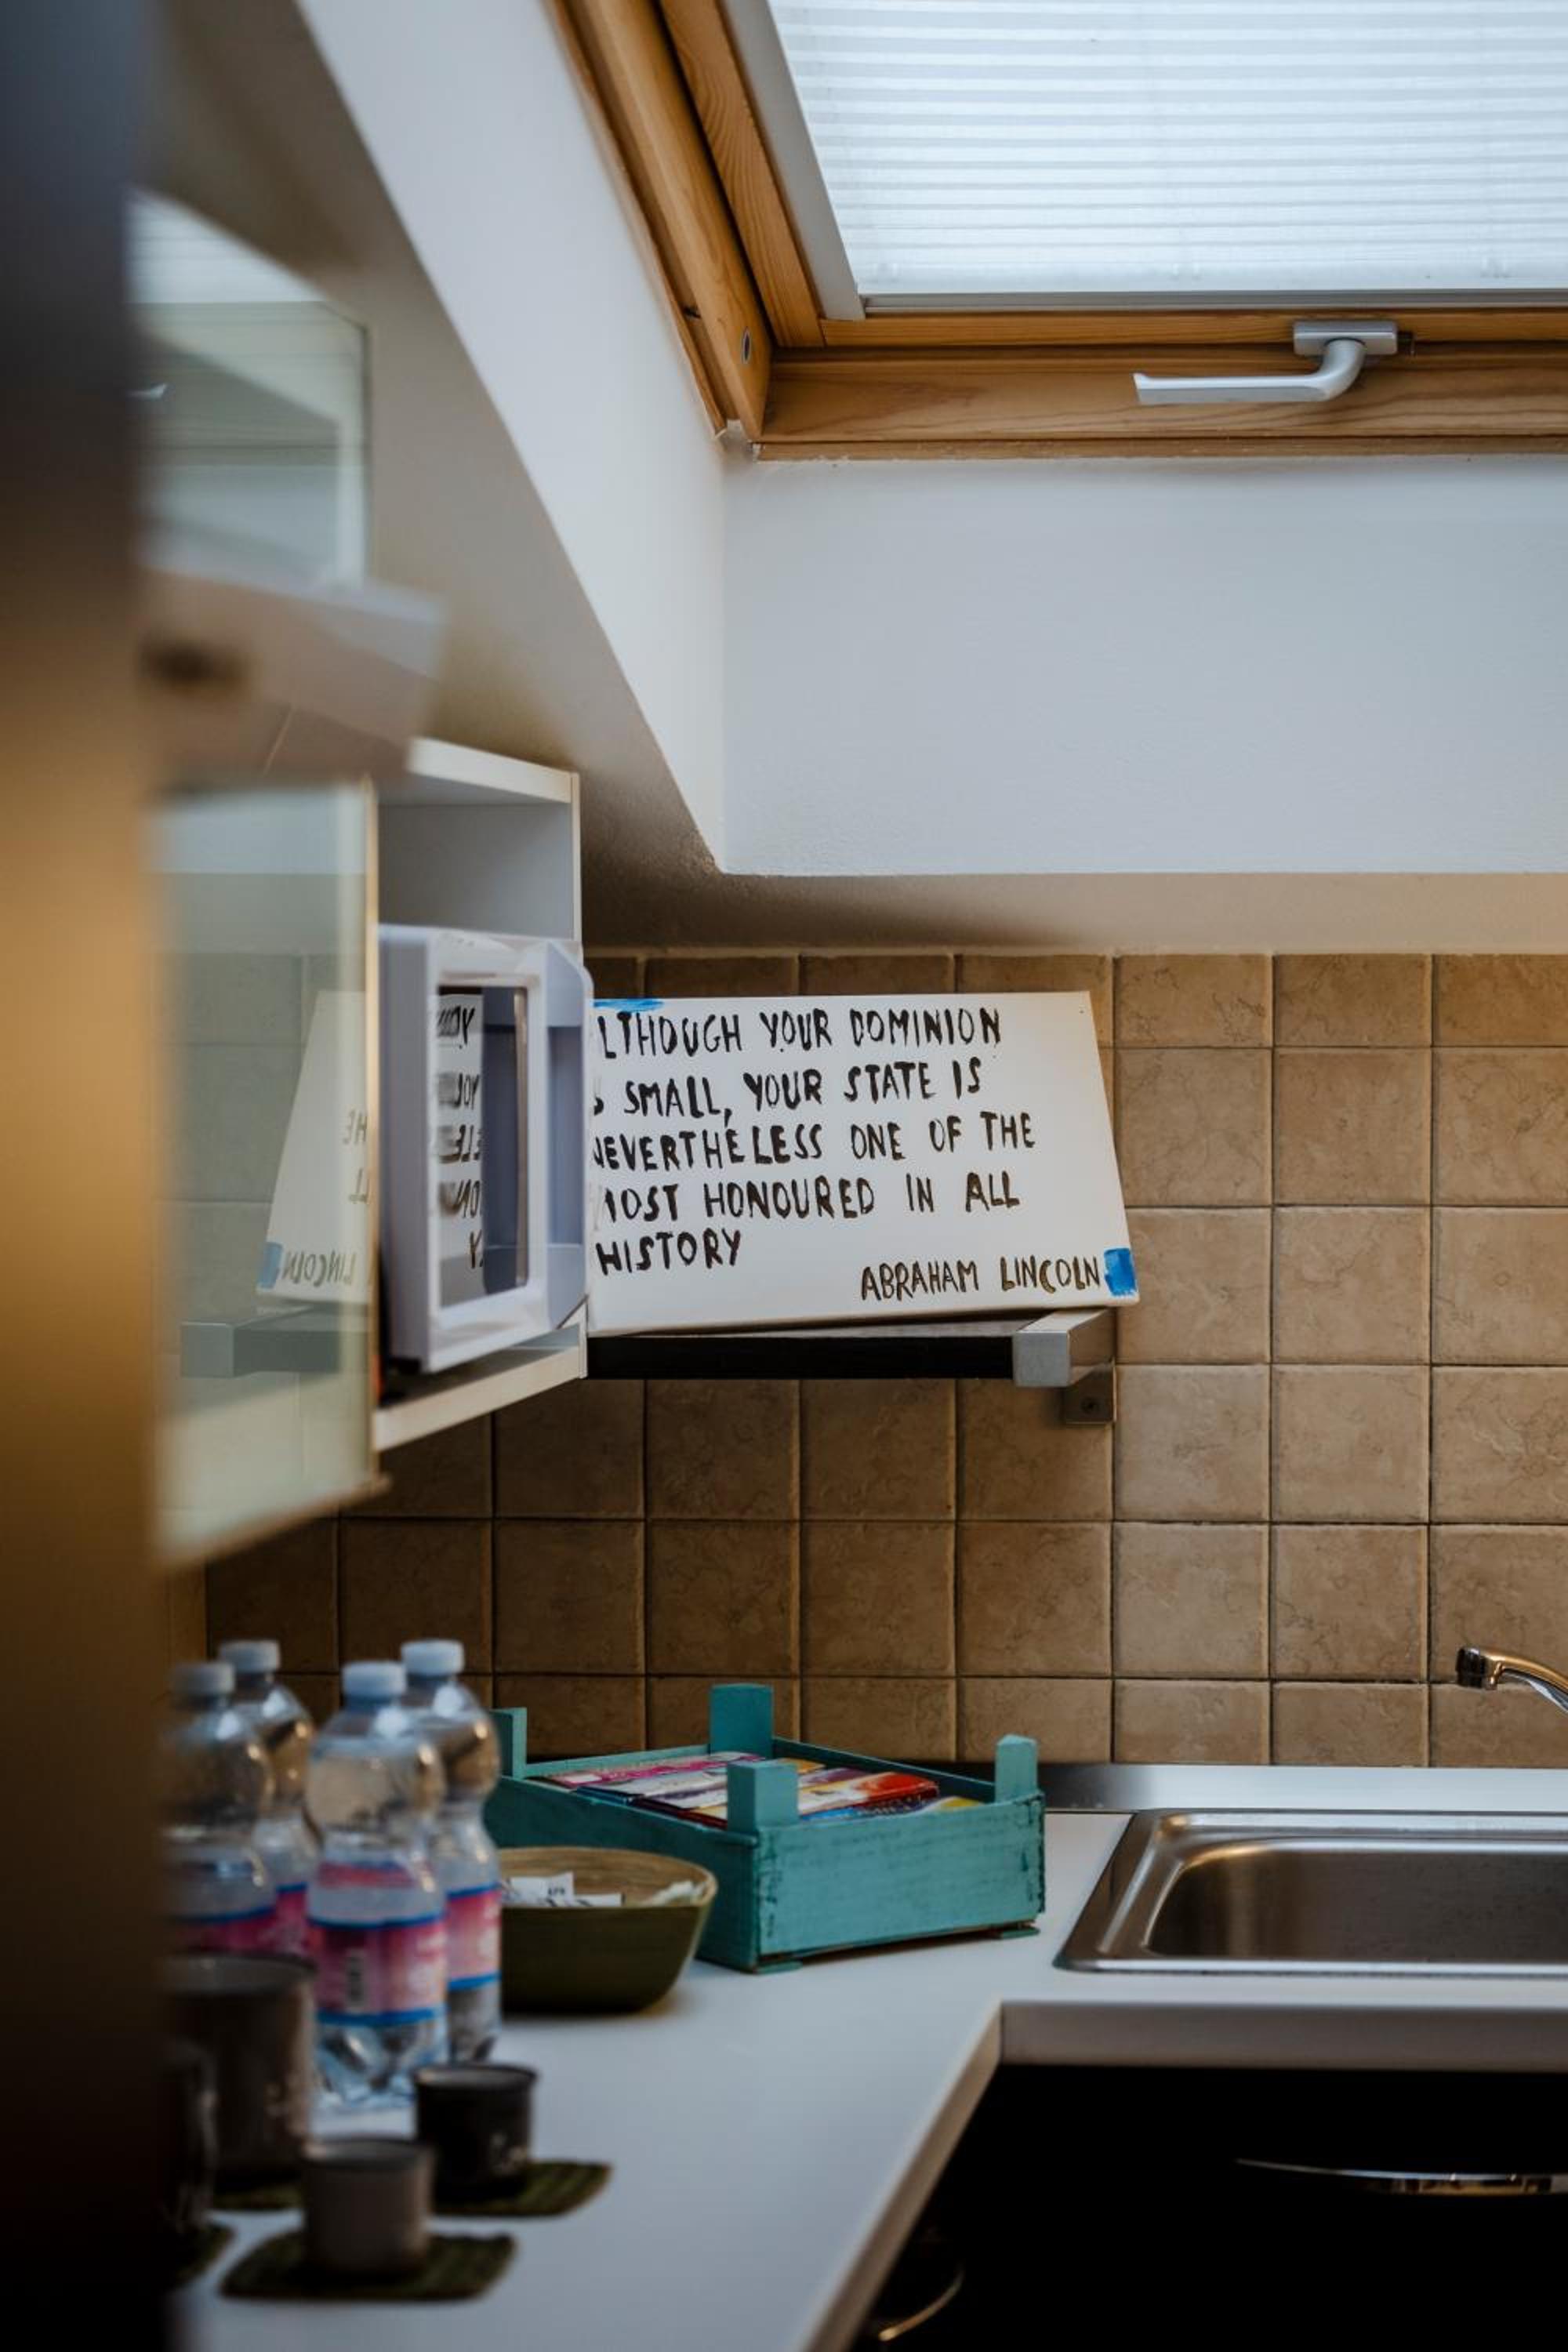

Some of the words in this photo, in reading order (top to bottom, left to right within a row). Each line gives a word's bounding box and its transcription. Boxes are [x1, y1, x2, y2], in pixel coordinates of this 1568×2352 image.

[597, 1011, 742, 1059] LTHOUGH
[759, 1007, 833, 1053] YOUR
[849, 1007, 1001, 1047] DOMINION
[623, 1075, 732, 1128] SMALL,
[742, 1068, 822, 1112] YOUR
[844, 1061, 934, 1105] STATE
[952, 1056, 982, 1099] IS
[850, 1121, 906, 1161] ONE
[928, 1115, 961, 1152] OF
[979, 1111, 1036, 1151] THE
[703, 1174, 875, 1219] HONOURED
[906, 1173, 935, 1213] IN
[965, 1171, 1020, 1213] ALL
[595, 1227, 741, 1276] HISTORY
[861, 1260, 979, 1301] ABRAHAM
[1000, 1255, 1100, 1294] LINCOLN
